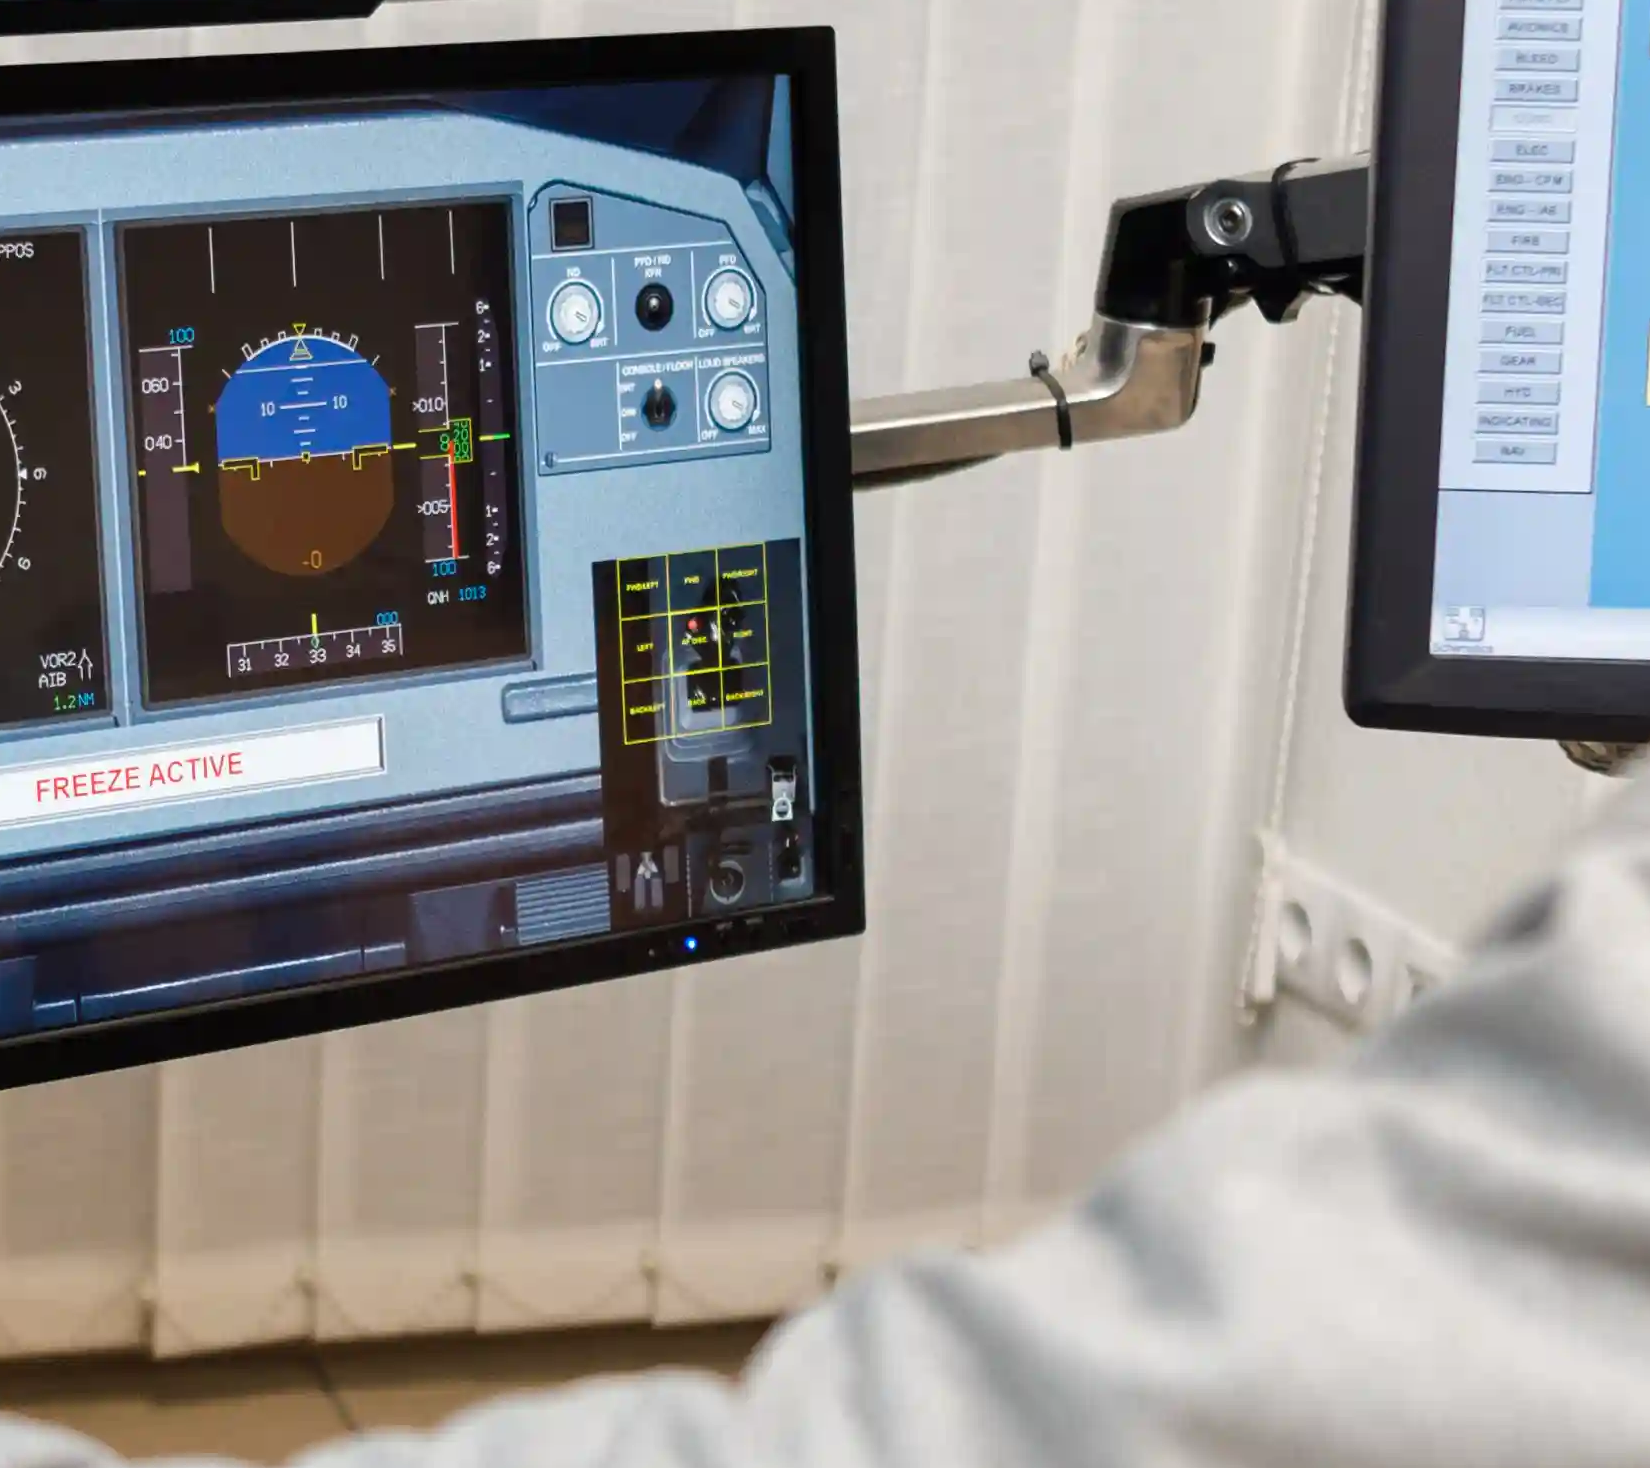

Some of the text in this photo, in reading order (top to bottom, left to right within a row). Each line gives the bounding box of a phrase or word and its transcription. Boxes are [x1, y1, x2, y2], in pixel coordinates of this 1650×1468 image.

[1508, 22, 1569, 34] AVIONICS
[1516, 53, 1559, 65] BLEED
[1508, 84, 1561, 95] BRAKES
[567, 268, 581, 277] ND
[168, 328, 195, 344] 100
[141, 378, 169, 394] 060
[260, 395, 348, 417] 10 10
[145, 435, 173, 451] 040
[431, 561, 457, 577] 100
[427, 586, 487, 605] QNH 1013
[376, 611, 399, 626] 000
[40, 651, 77, 668] VOR2
[237, 638, 397, 672] 31 32 33 34 35
[38, 670, 67, 688] AIB
[53, 692, 95, 711] 1.2 NM
[36, 751, 243, 802] FREEZE ACTIVE
